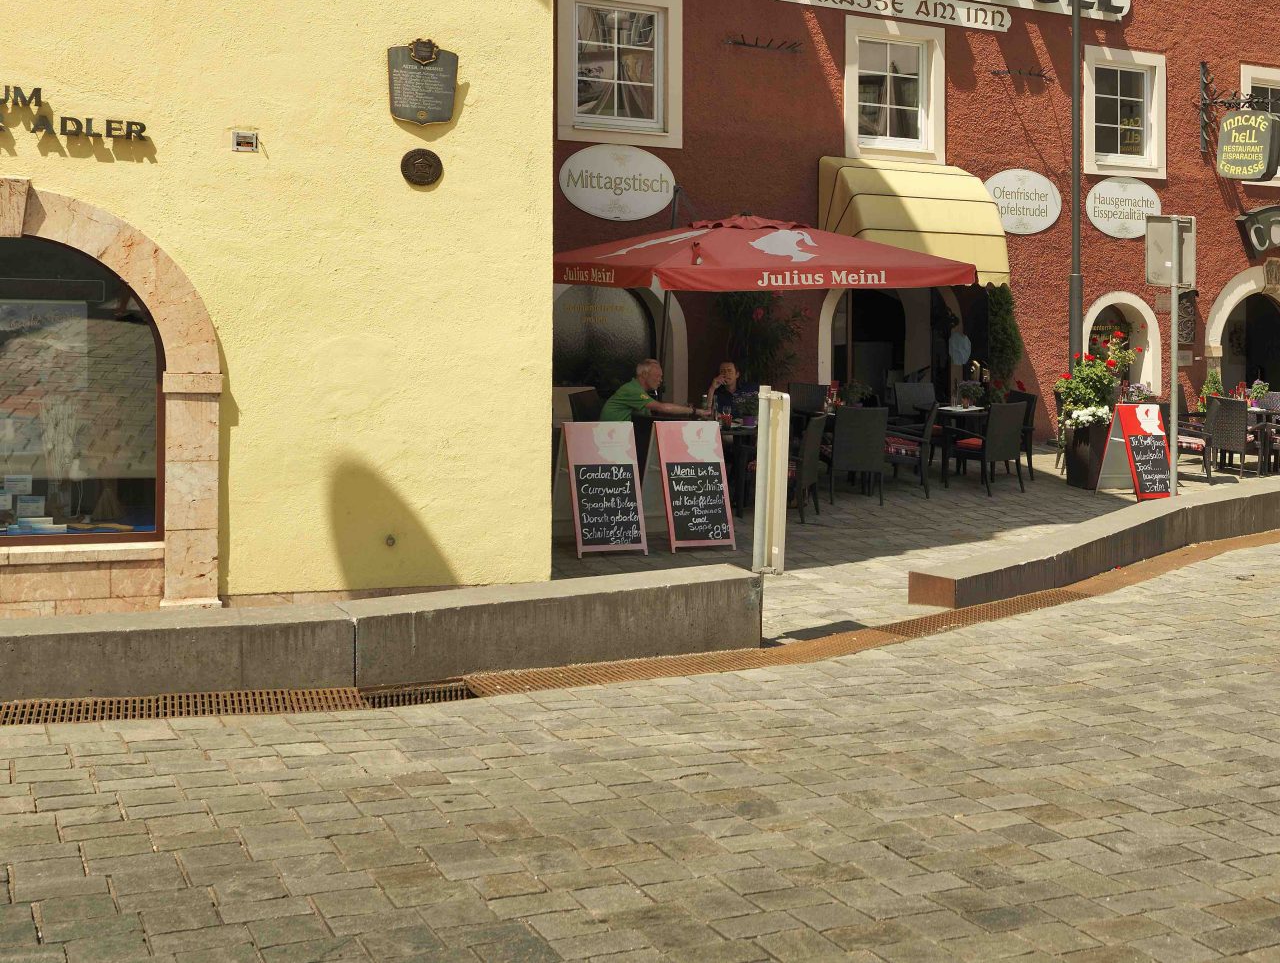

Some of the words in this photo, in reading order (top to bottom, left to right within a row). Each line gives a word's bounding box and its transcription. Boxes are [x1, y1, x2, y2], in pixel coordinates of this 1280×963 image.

[915, 0, 956, 21] AM
[966, 6, 1005, 27] INN
[30, 115, 148, 141] ADLER
[1222, 152, 1263, 160] EISPARADIES
[1223, 145, 1264, 153] RESTAURANT
[1220, 160, 1265, 175] TERRASSE
[566, 168, 670, 195] Mittagstisch
[993, 186, 1048, 202] Ofenfrischer
[1093, 193, 1155, 210] Hausgemachte
[996, 203, 1048, 219] pfelstrudel
[563, 267, 589, 282] Julius
[757, 270, 824, 287] Julius
[830, 270, 887, 285] Meinl
[579, 466, 611, 480] Cordon
[611, 466, 633, 480] Bleu
[670, 465, 696, 477] Menü
[698, 468, 707, 476] bis
[581, 481, 631, 496] Currywurst
[582, 512, 609, 524] Dorsch
[687, 523, 713, 533] Suppe
